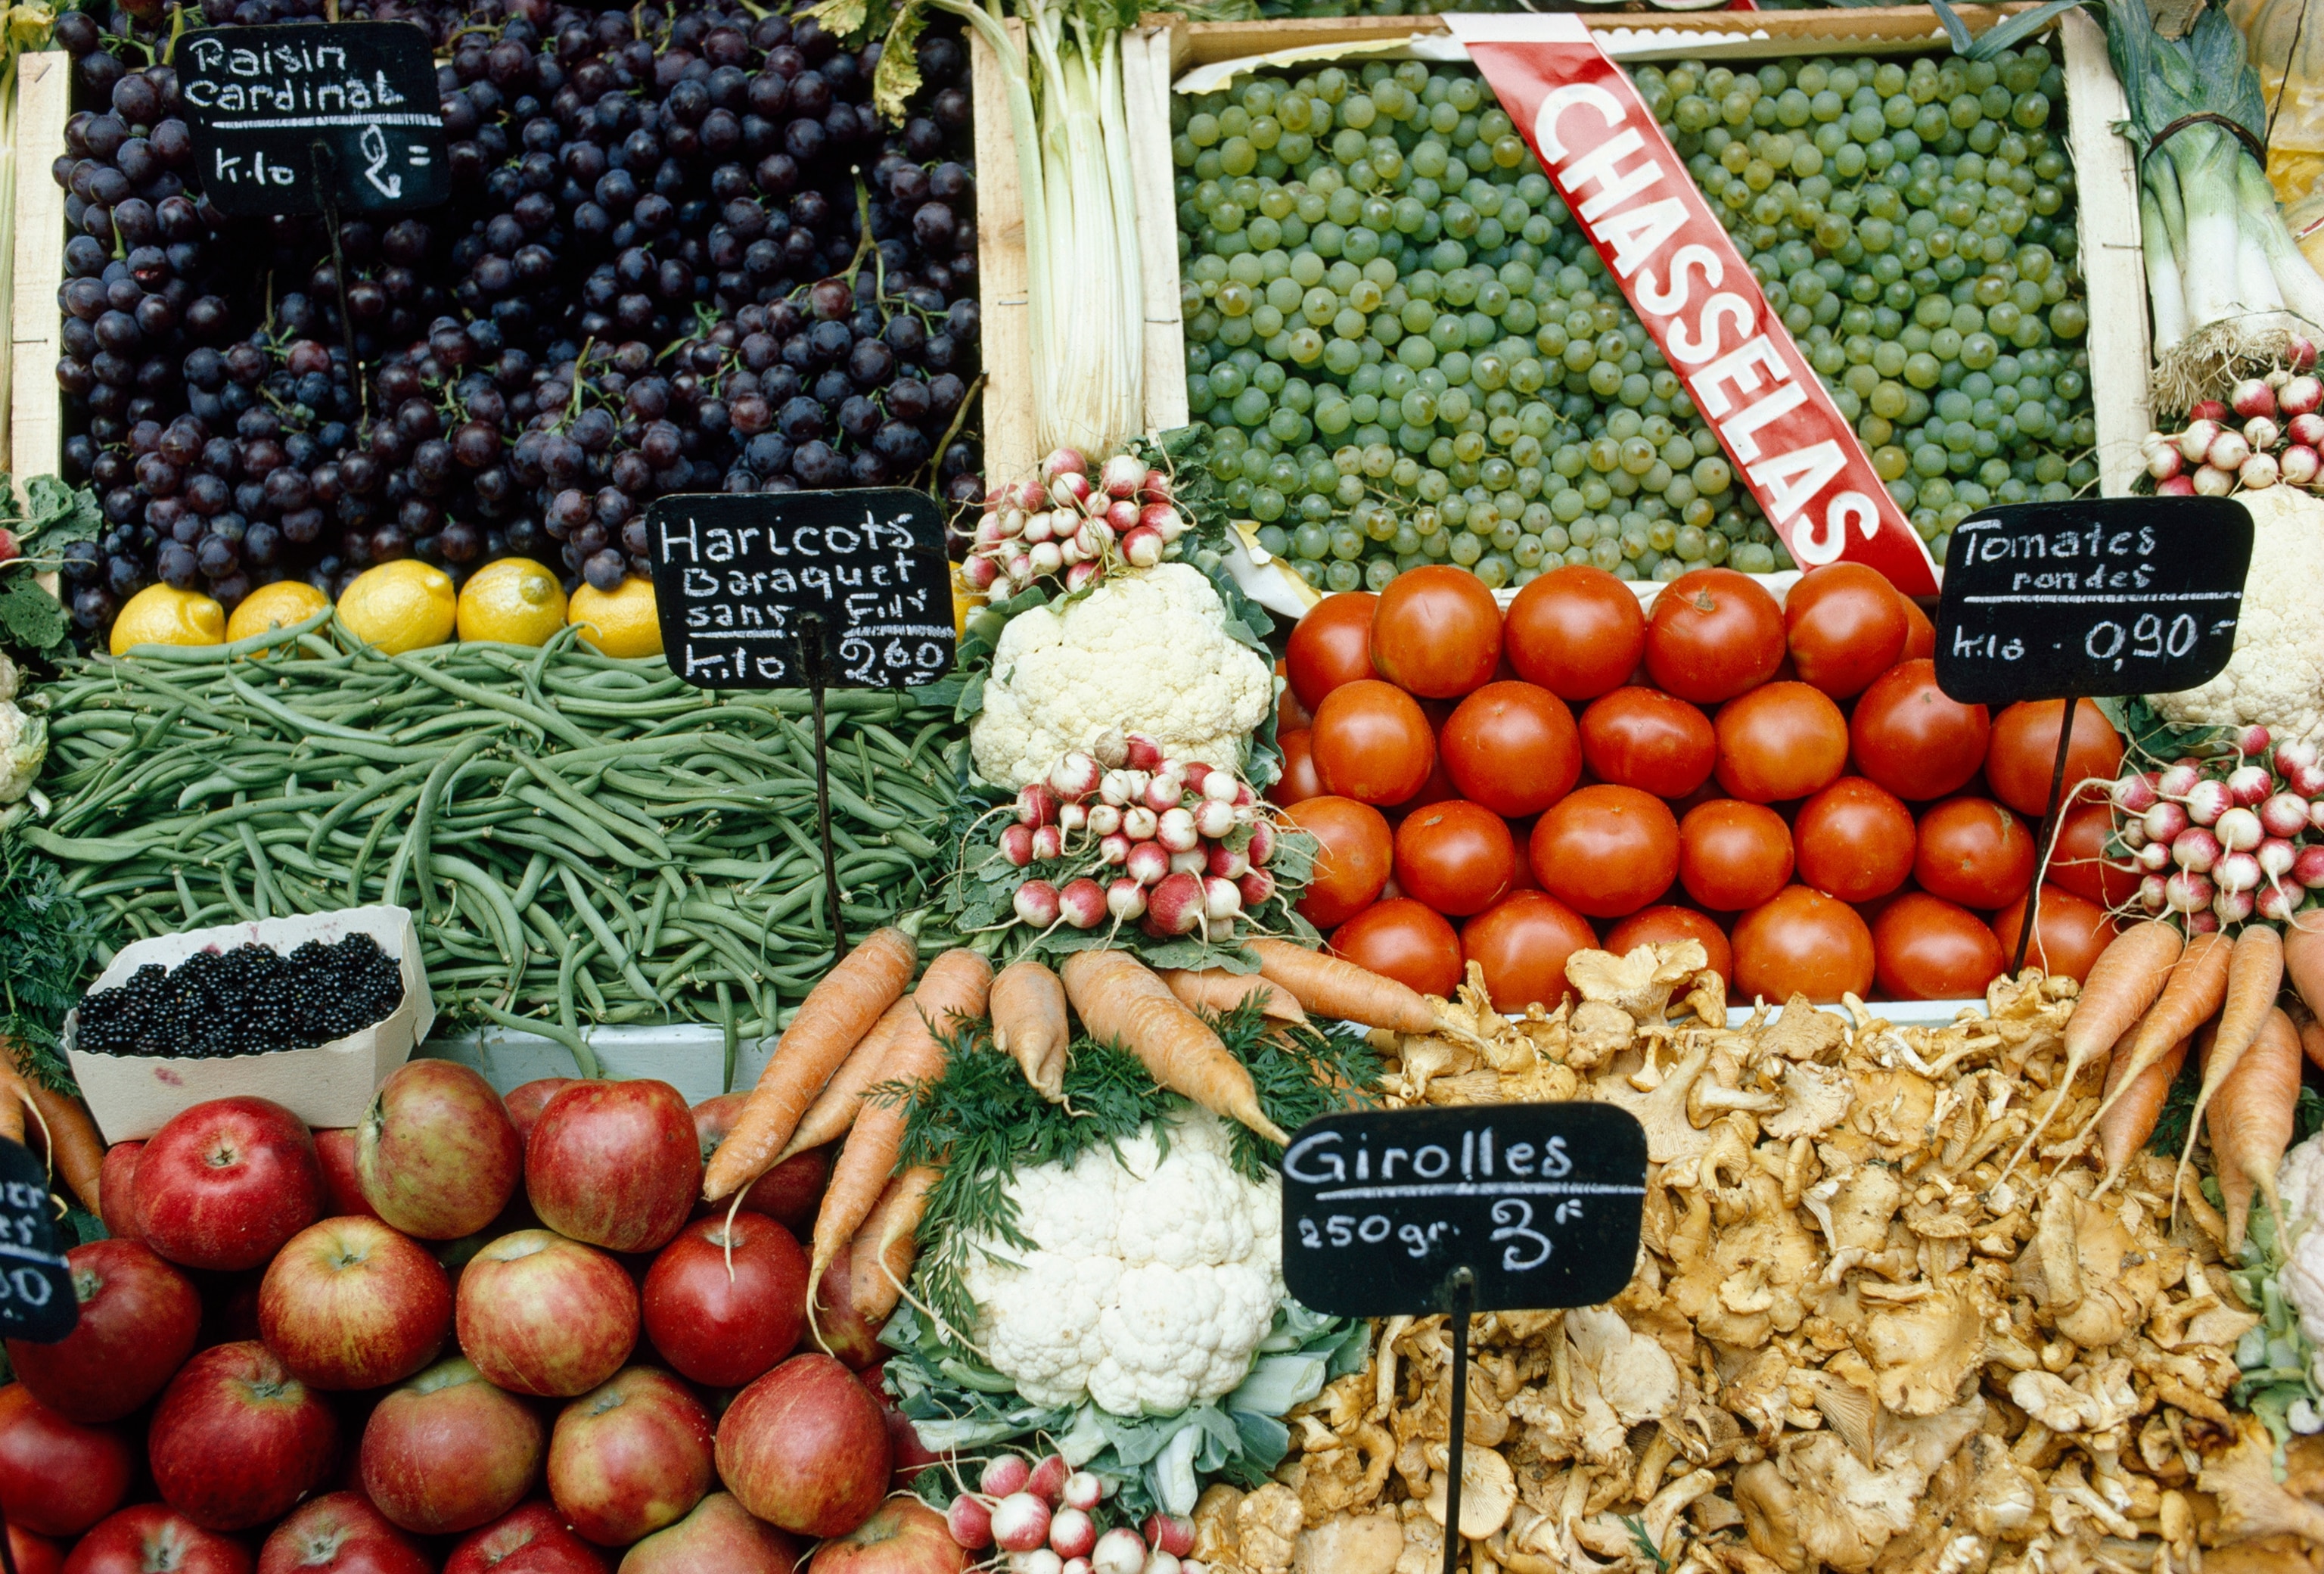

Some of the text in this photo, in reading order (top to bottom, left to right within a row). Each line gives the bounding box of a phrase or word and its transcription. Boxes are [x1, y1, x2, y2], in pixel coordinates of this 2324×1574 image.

[188, 37, 347, 76] Raisin
[1534, 82, 1879, 565] CHASSELAS
[660, 510, 915, 564] Haricots
[1958, 519, 2156, 566] Tomates
[682, 552, 915, 602] Baraquet
[2012, 563, 2156, 592] rondes
[1283, 1126, 1572, 1184] Girolles
